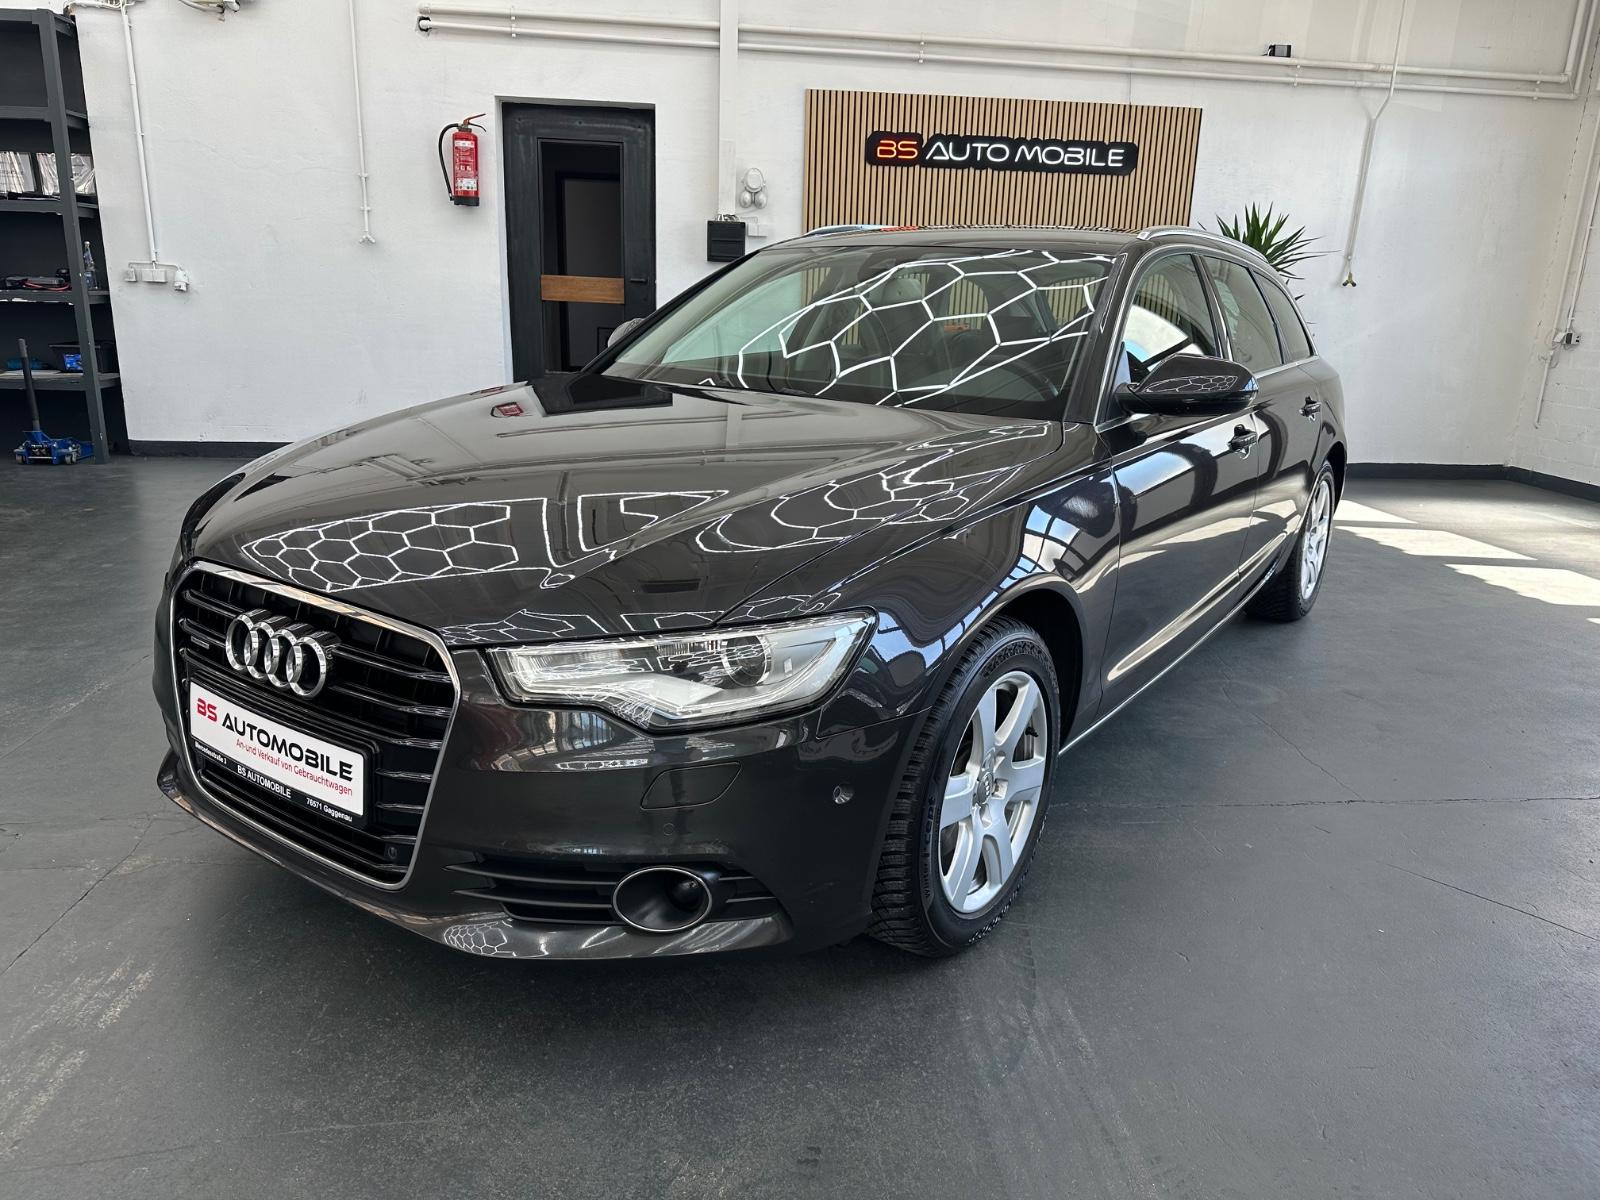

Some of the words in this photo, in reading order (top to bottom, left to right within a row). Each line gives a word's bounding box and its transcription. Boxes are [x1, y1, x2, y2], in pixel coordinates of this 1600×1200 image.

[876, 139, 919, 160] BS
[926, 141, 1010, 163] AUTO
[1014, 145, 1125, 168] MOBILE
[196, 698, 218, 722] BS
[222, 712, 353, 782] AUTOMOBILE
[237, 764, 247, 777] BS
[246, 769, 292, 799] AUTOMOBILE
[257, 748, 280, 768] Verkauf
[281, 761, 293, 772] von
[293, 765, 353, 797] Gebrauchtwagen
[323, 804, 353, 823] Gaggenau
